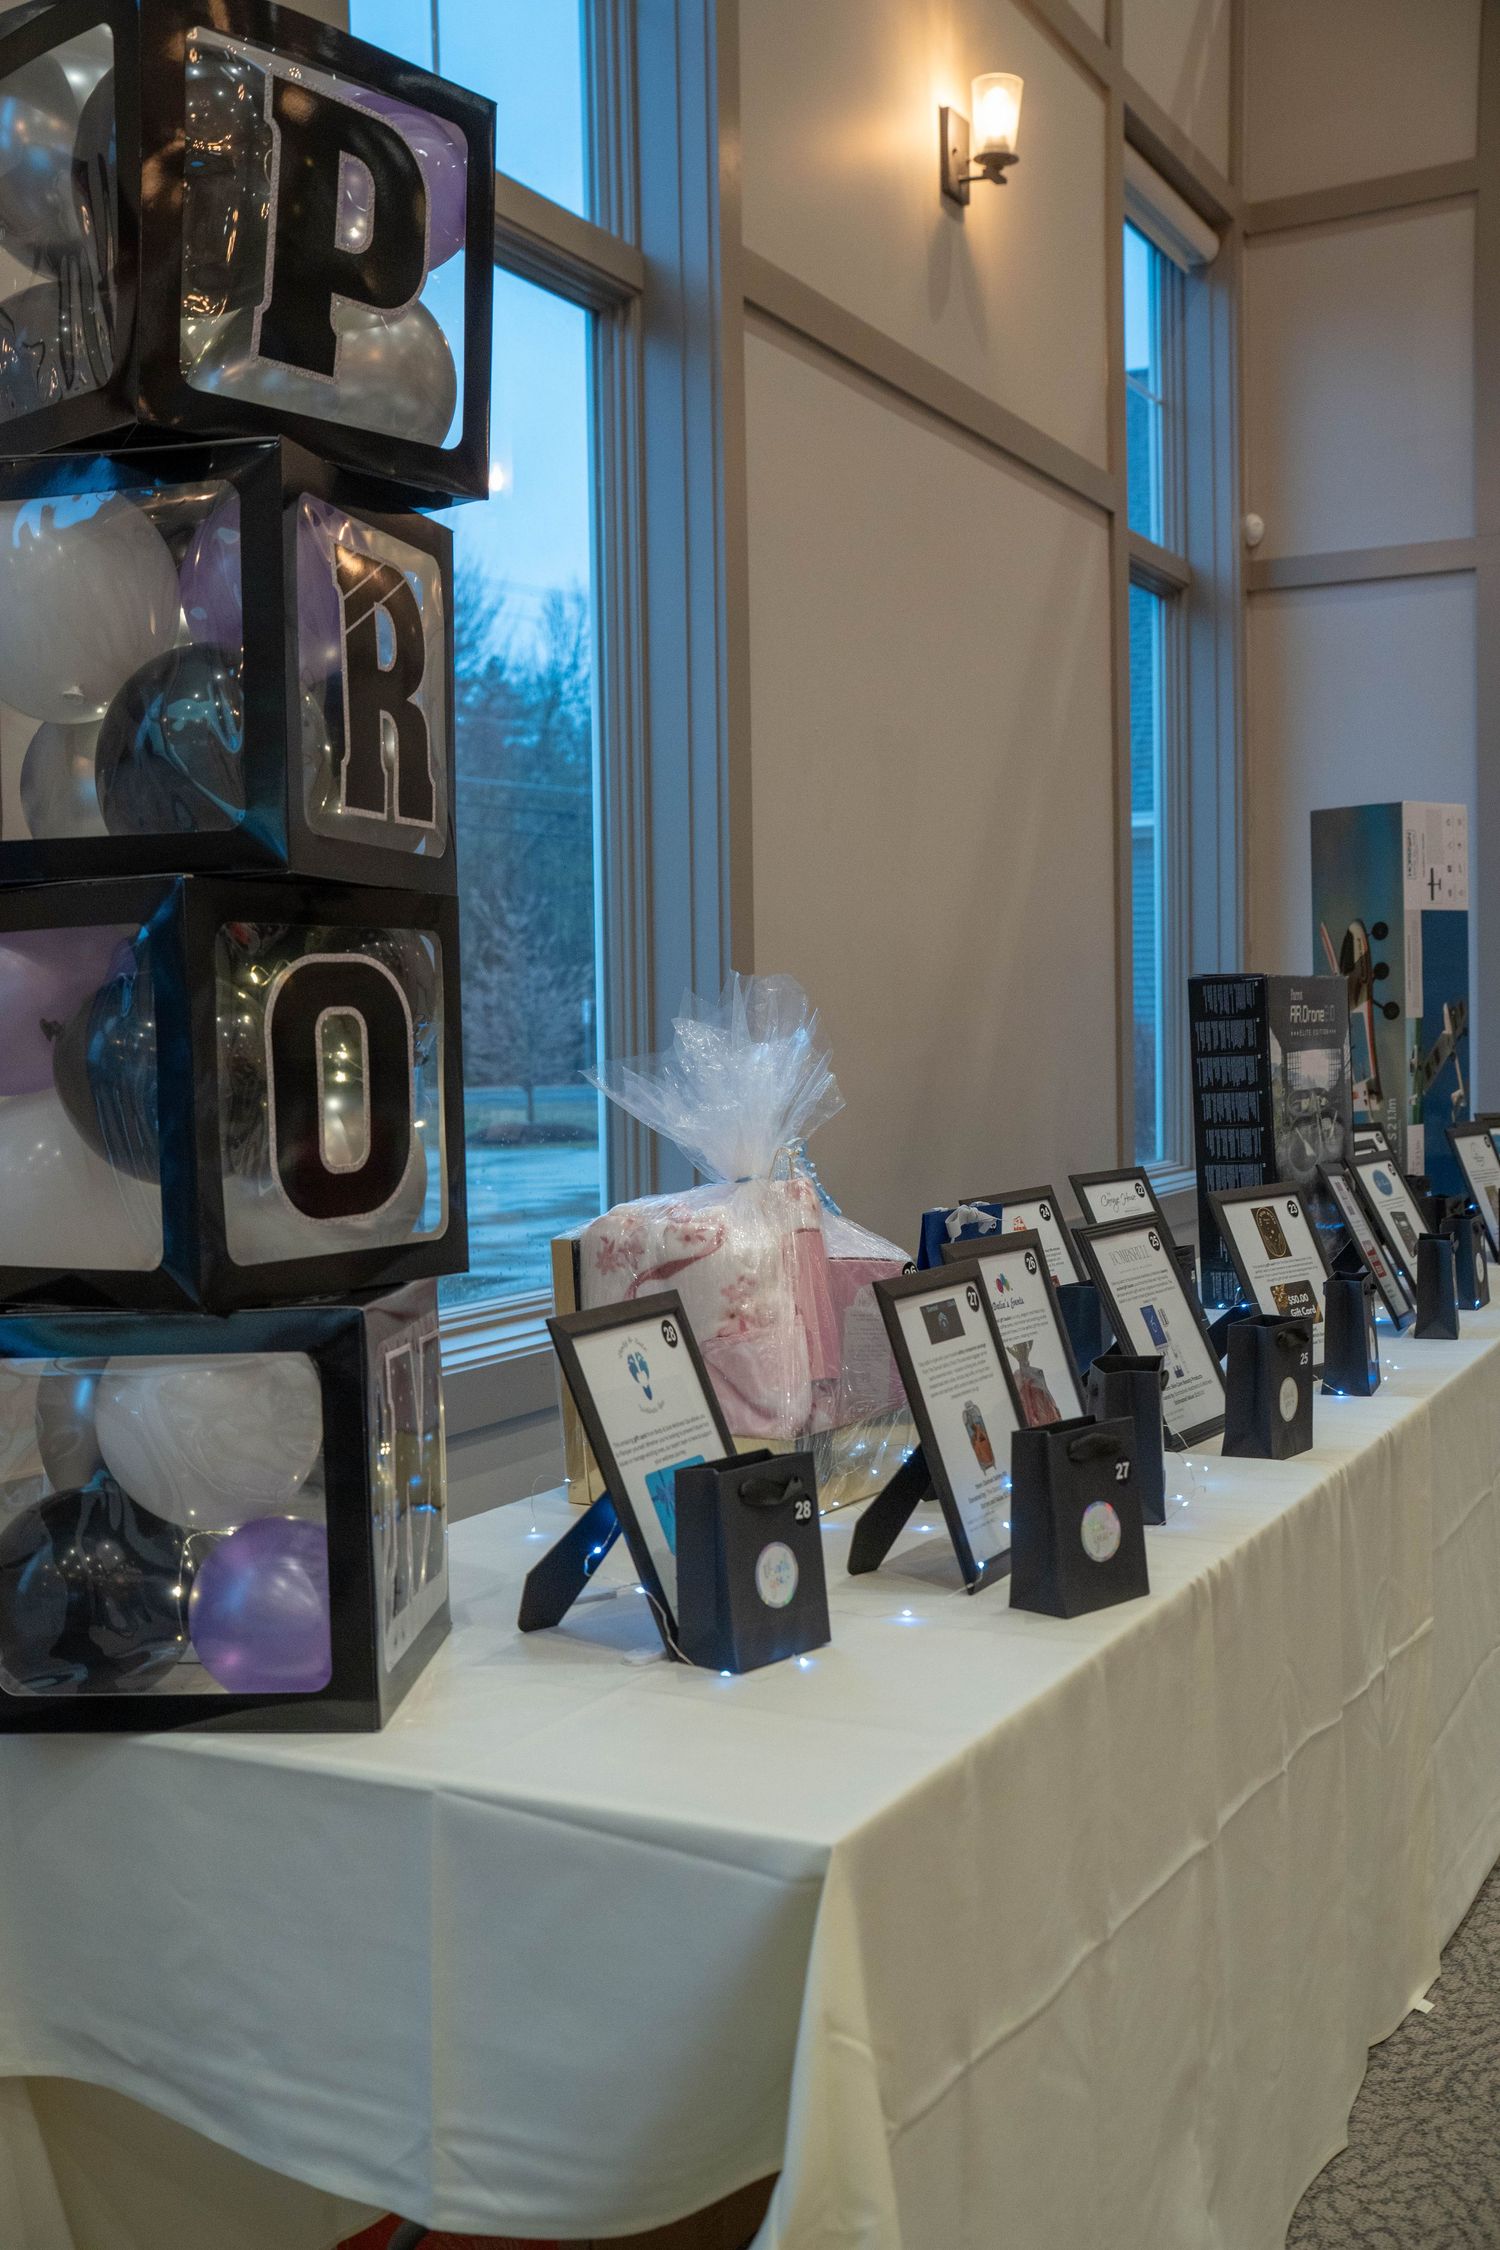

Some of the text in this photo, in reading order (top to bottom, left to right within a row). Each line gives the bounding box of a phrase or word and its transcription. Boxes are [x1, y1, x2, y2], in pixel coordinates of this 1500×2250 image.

[250, 67, 431, 385] P
[331, 539, 437, 829] R
[264, 952, 415, 1223] O
[1026, 1256, 1036, 1271] 26
[967, 1291, 978, 1306] 27
[1287, 1293, 1309, 1305] $50.00
[1291, 1304, 1317, 1317] Gift Card
[663, 1325, 677, 1342] 28
[1300, 1352, 1309, 1365] 25
[1115, 1461, 1130, 1480] 27
[795, 1500, 811, 1520] 28
